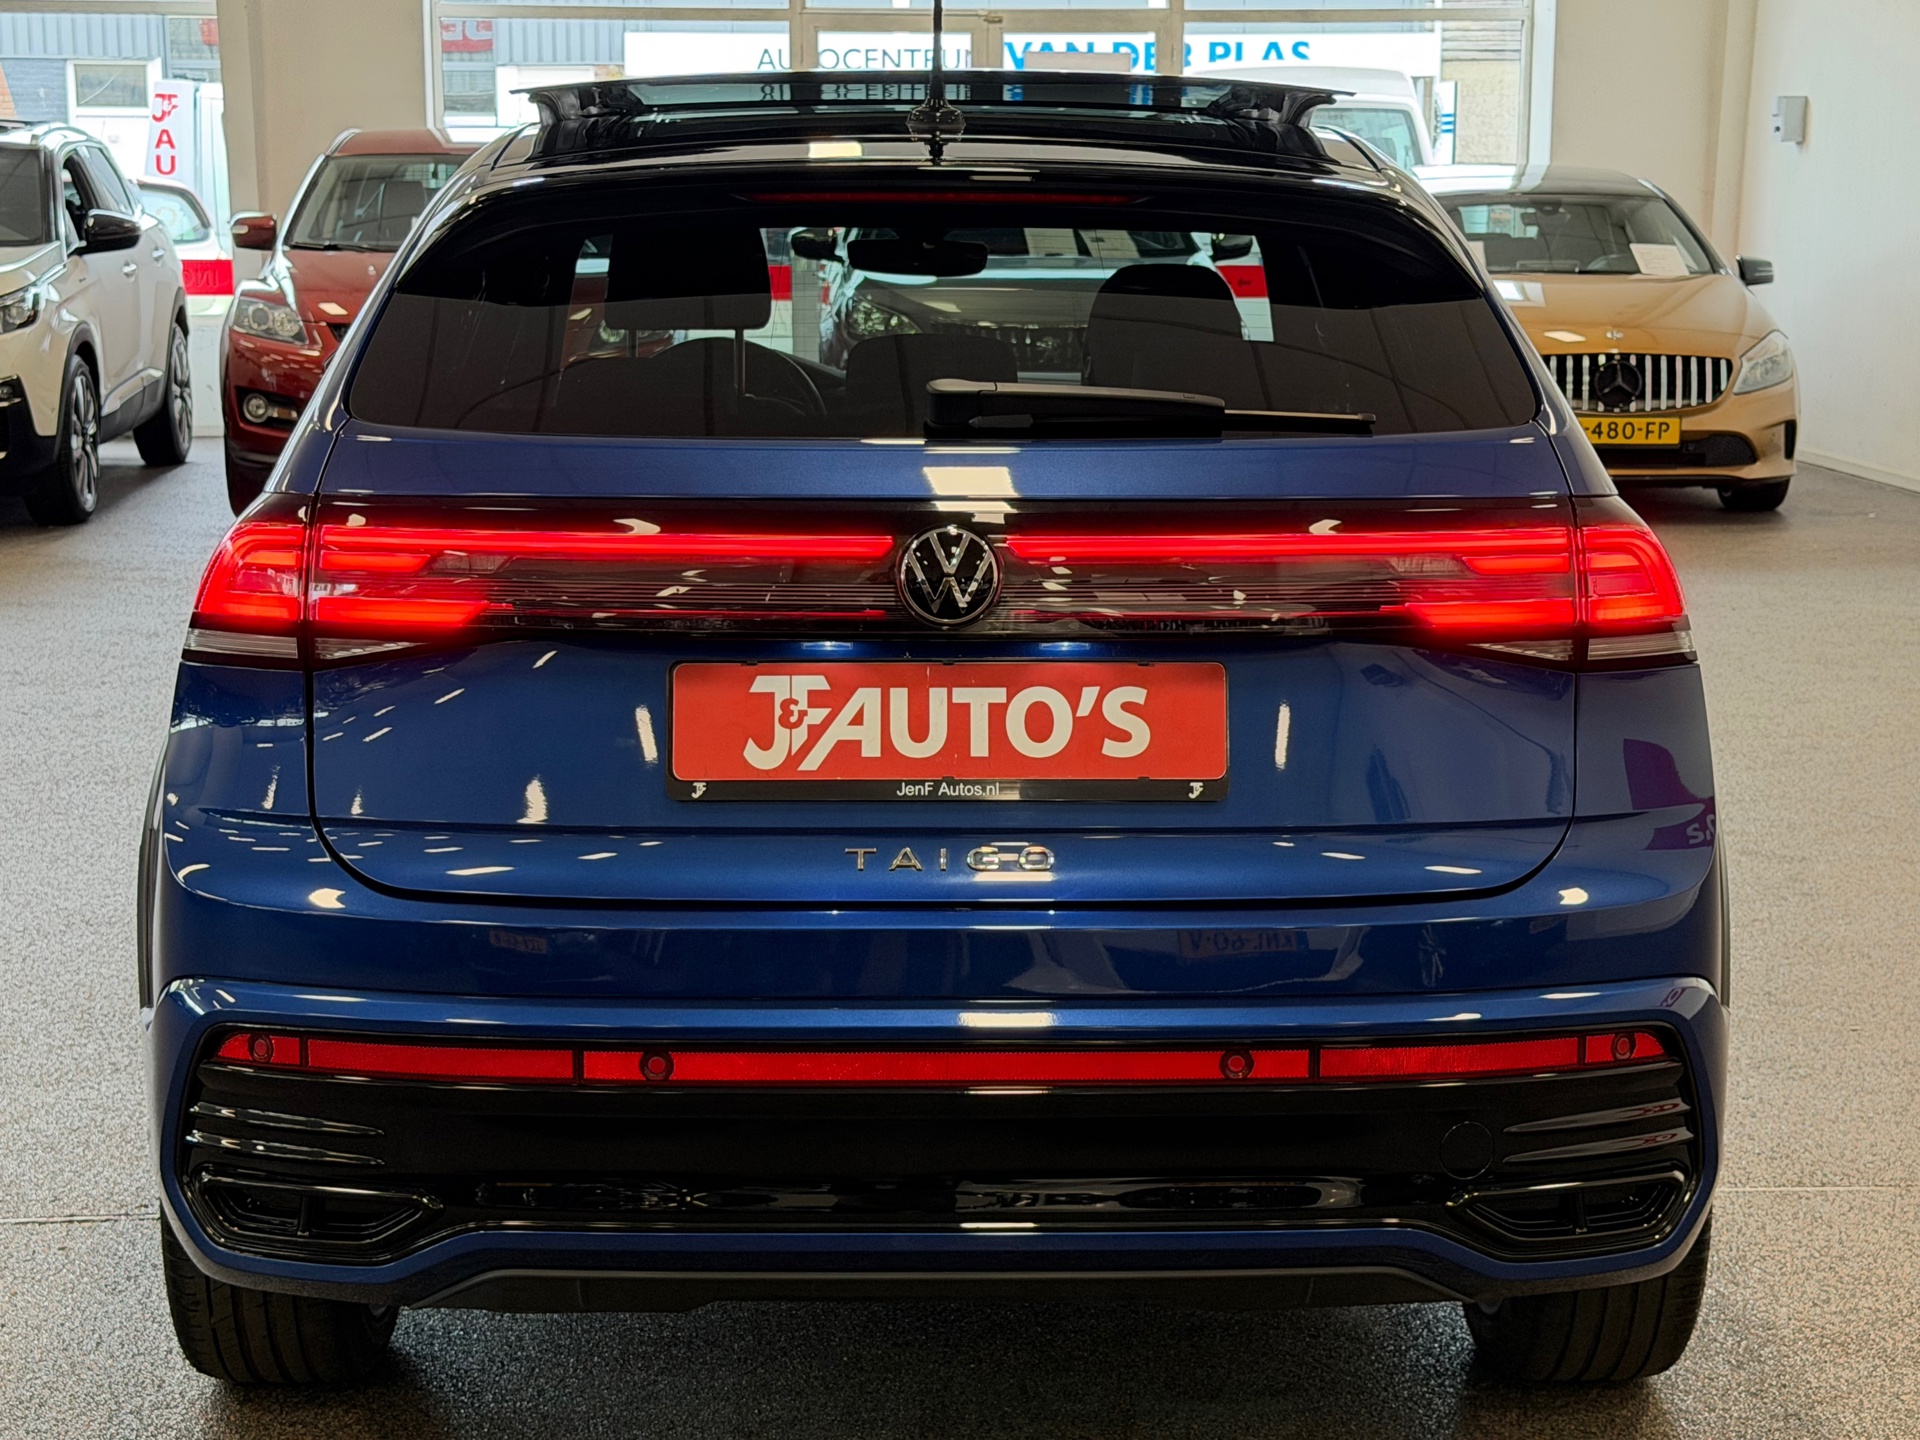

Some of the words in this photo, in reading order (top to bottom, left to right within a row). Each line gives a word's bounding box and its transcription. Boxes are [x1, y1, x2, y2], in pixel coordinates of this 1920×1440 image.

[757, 48, 972, 69] AUOCENTRU
[1584, 421, 1671, 440] -480-FP
[797, 686, 1151, 771] AUTO'S
[896, 782, 934, 796] JenF
[938, 782, 1000, 796] Autos.nl
[844, 846, 1055, 871] TAIGO
